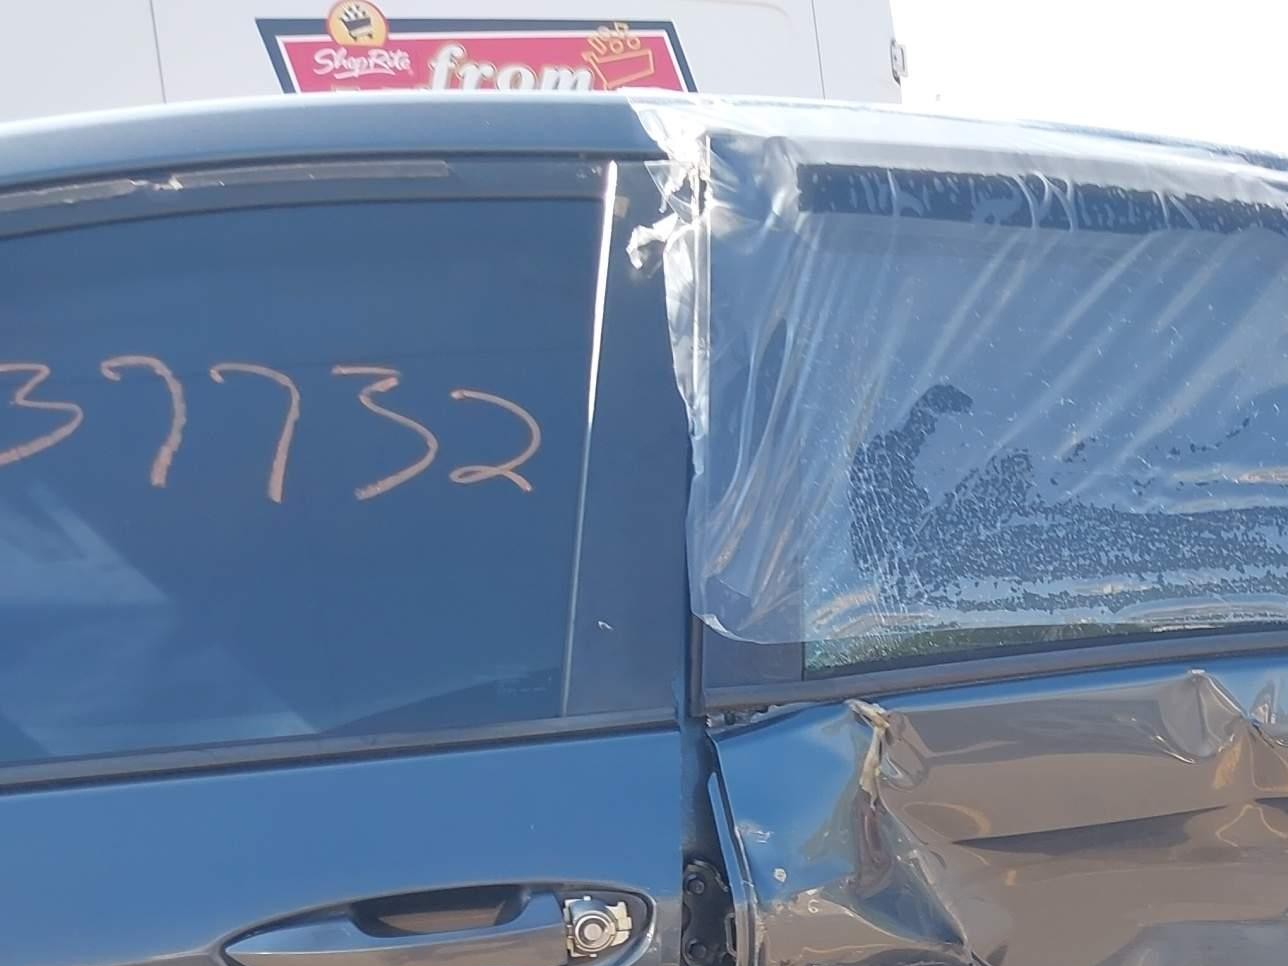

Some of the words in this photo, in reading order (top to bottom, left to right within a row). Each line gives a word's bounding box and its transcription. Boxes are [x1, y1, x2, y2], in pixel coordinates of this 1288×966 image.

[313, 47, 412, 80] ShopRite
[429, 43, 594, 92] from
[0, 355, 541, 502] 37732
